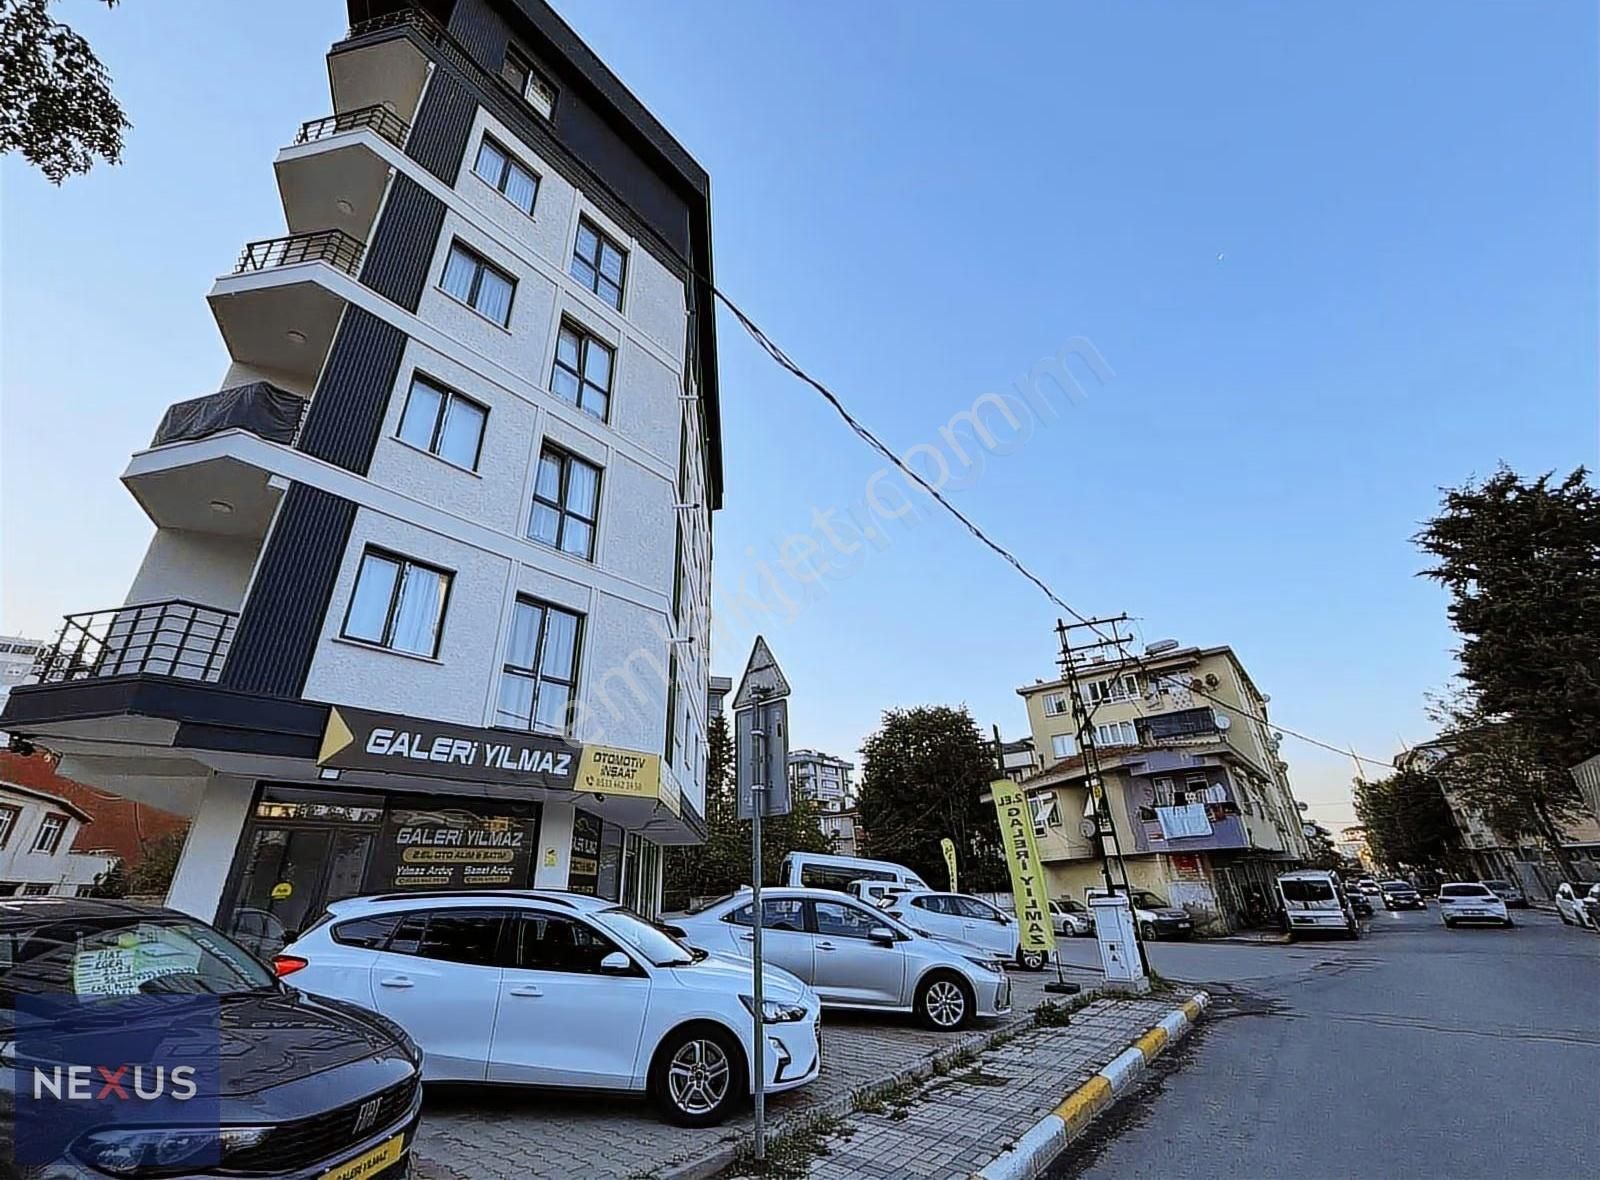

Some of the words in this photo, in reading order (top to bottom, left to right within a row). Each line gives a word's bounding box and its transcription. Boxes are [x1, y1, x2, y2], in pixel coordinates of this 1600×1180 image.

[484, 744, 572, 776] YILMAZ
[466, 829, 524, 847] YILMAZ
[353, 1097, 384, 1135] FIAT
